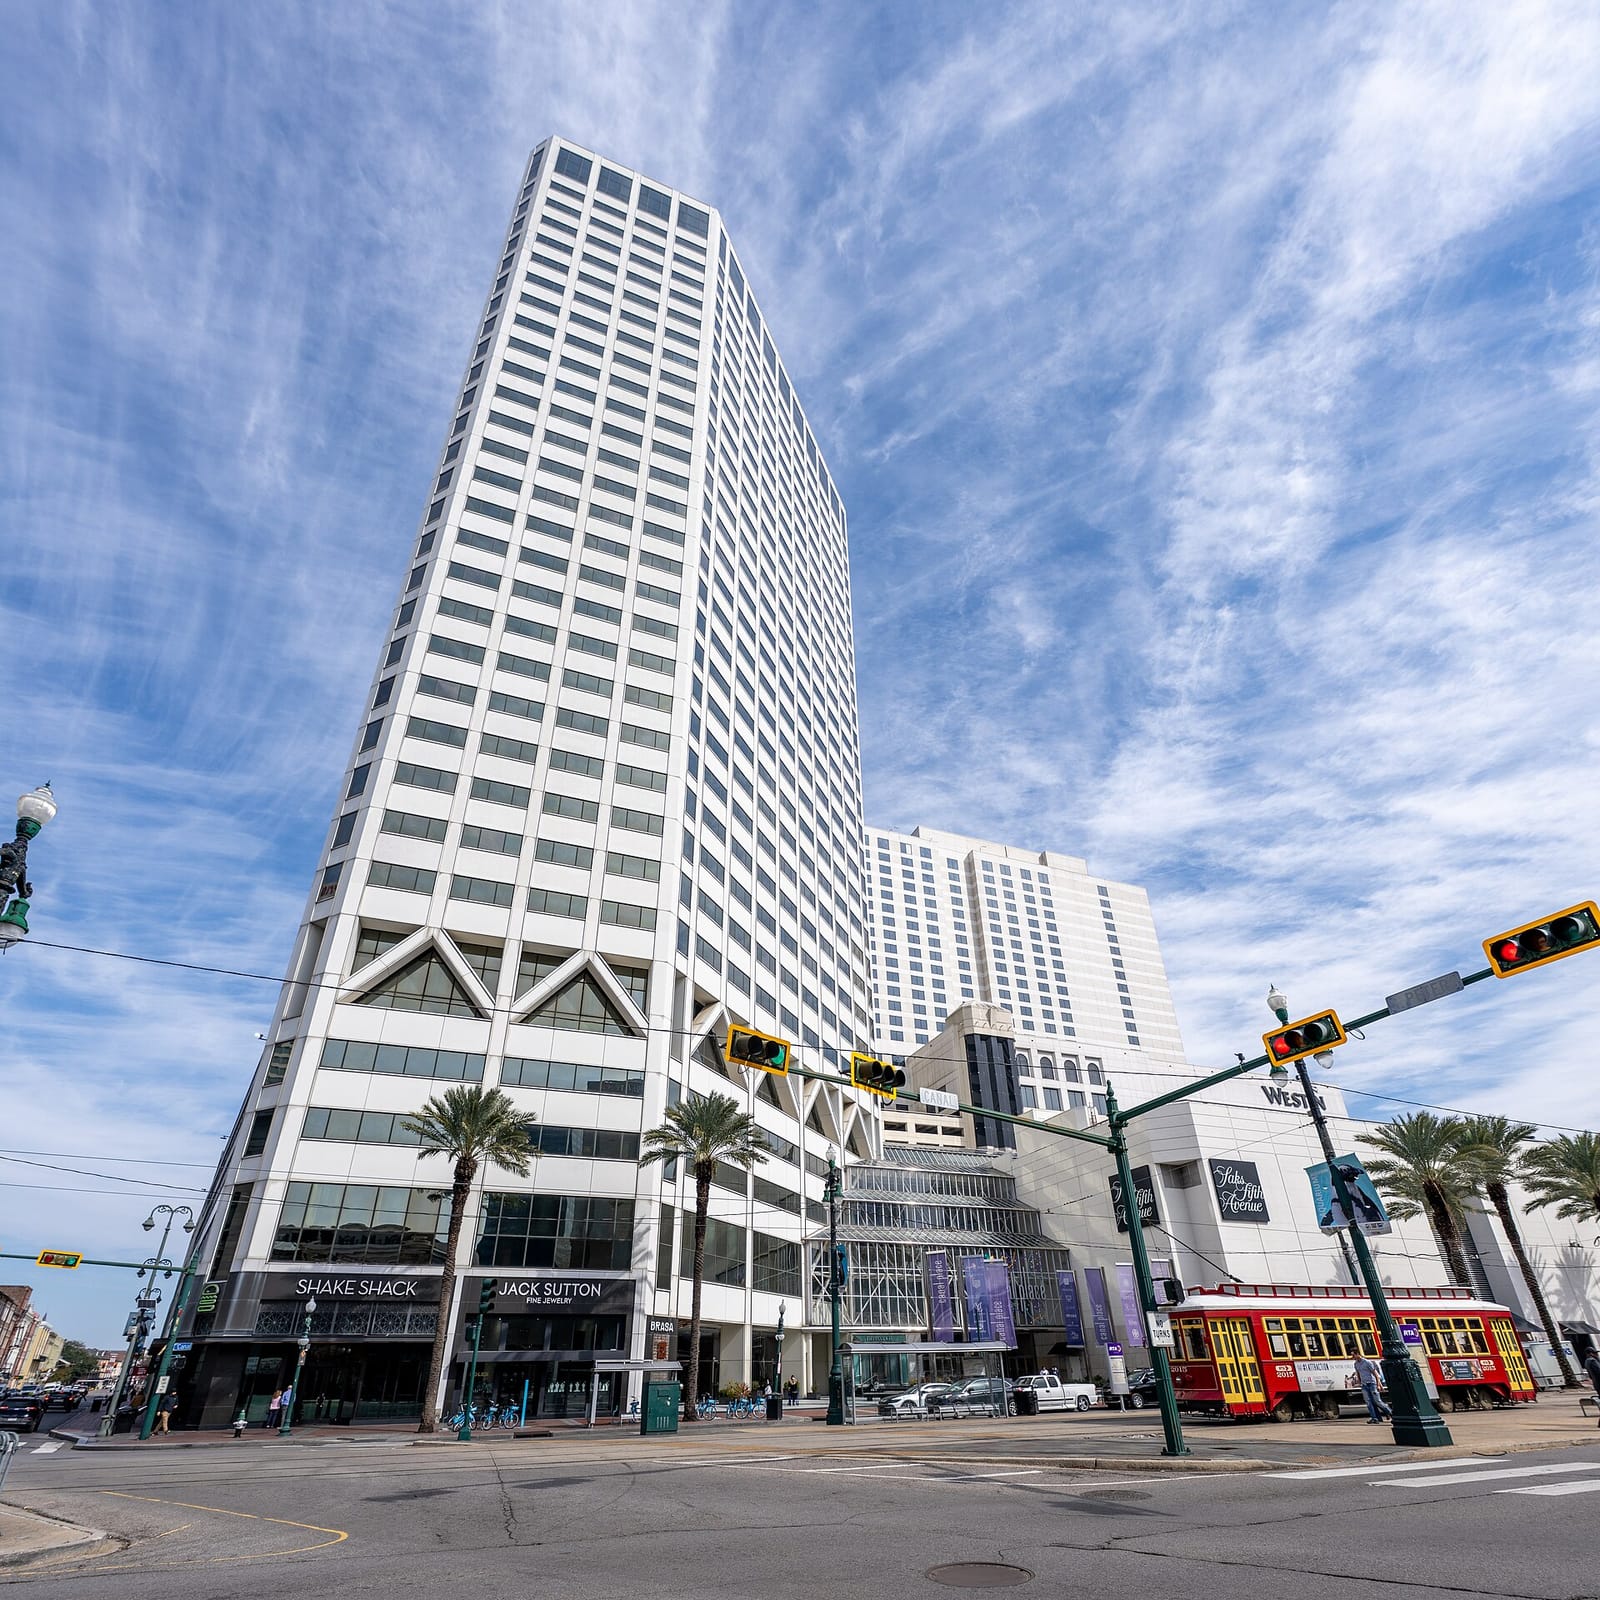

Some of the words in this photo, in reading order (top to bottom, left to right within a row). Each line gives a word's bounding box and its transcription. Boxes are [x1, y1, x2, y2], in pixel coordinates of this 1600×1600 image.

[1260, 1085, 1327, 1111] WESTN
[1213, 1165, 1245, 1191] Saks
[1219, 1190, 1263, 1213] Avenue
[930, 1260, 949, 1281] place
[296, 1279, 357, 1295] SHAKE
[358, 1280, 418, 1296] SHACK
[499, 1281, 541, 1296] JACK
[543, 1282, 602, 1297] SUTTON
[933, 1282, 947, 1304] canal
[542, 1297, 573, 1305] JEWELRY
[990, 1300, 1010, 1320] place
[1092, 1303, 1109, 1321] place
[650, 1320, 674, 1333] BRASA
[991, 1321, 1006, 1341] canal
[1095, 1322, 1108, 1341] canal
[1153, 1329, 1171, 1339] TURNS
